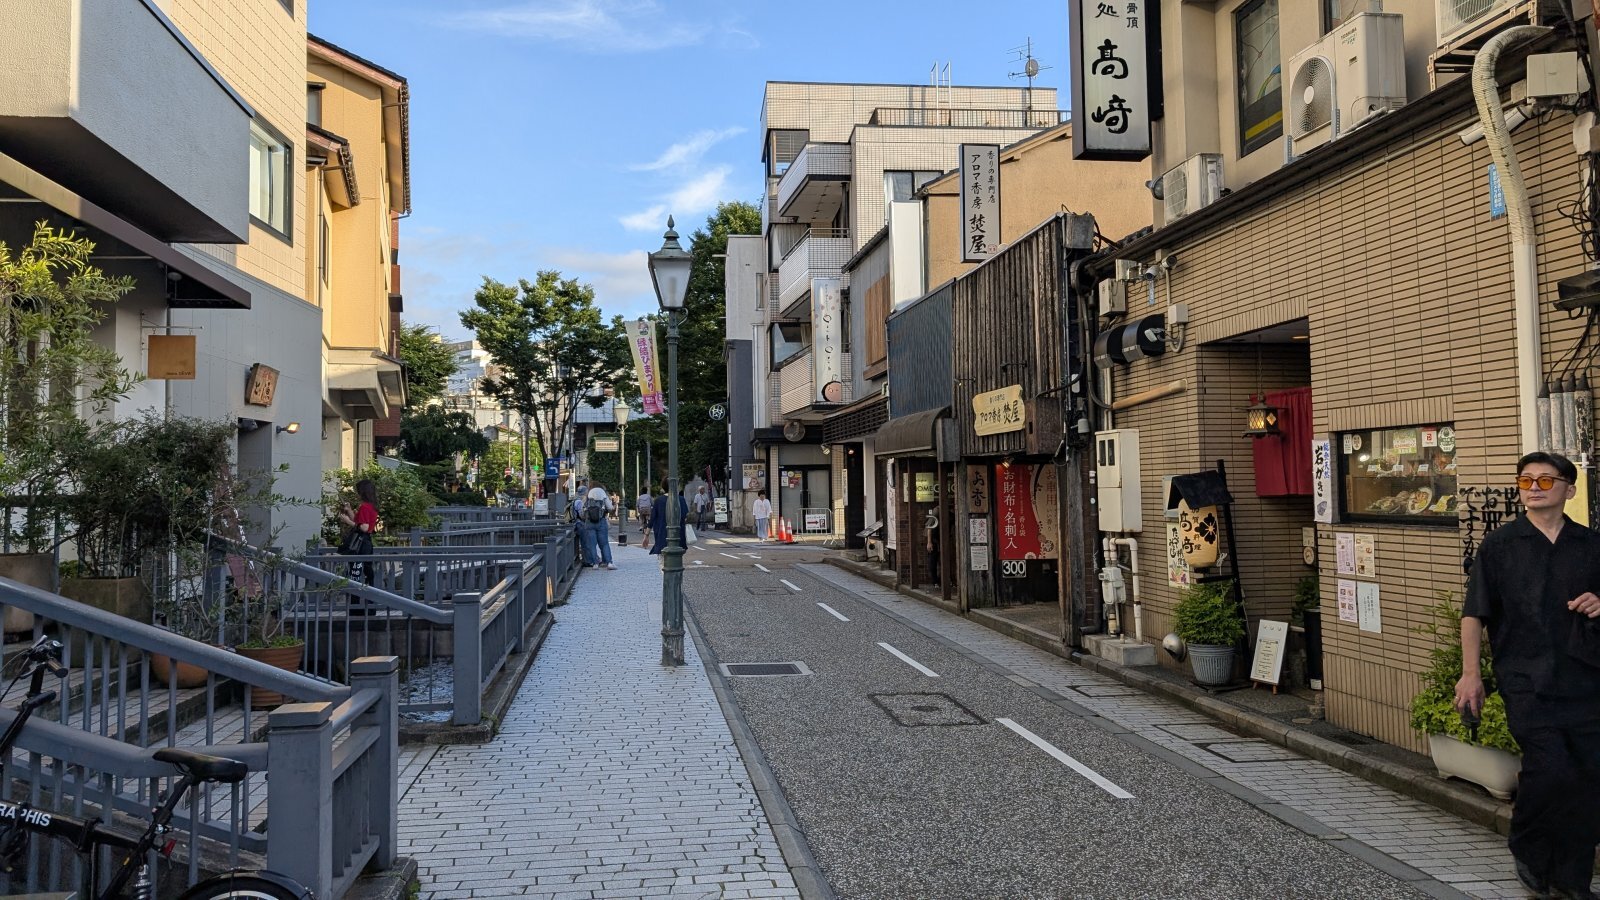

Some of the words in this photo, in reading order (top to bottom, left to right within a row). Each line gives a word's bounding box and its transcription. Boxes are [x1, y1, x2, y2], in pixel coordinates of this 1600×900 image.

[971, 154, 983, 210] アロマ香房
[987, 150, 996, 204] 香りの専門店
[1003, 561, 1025, 574] 300
